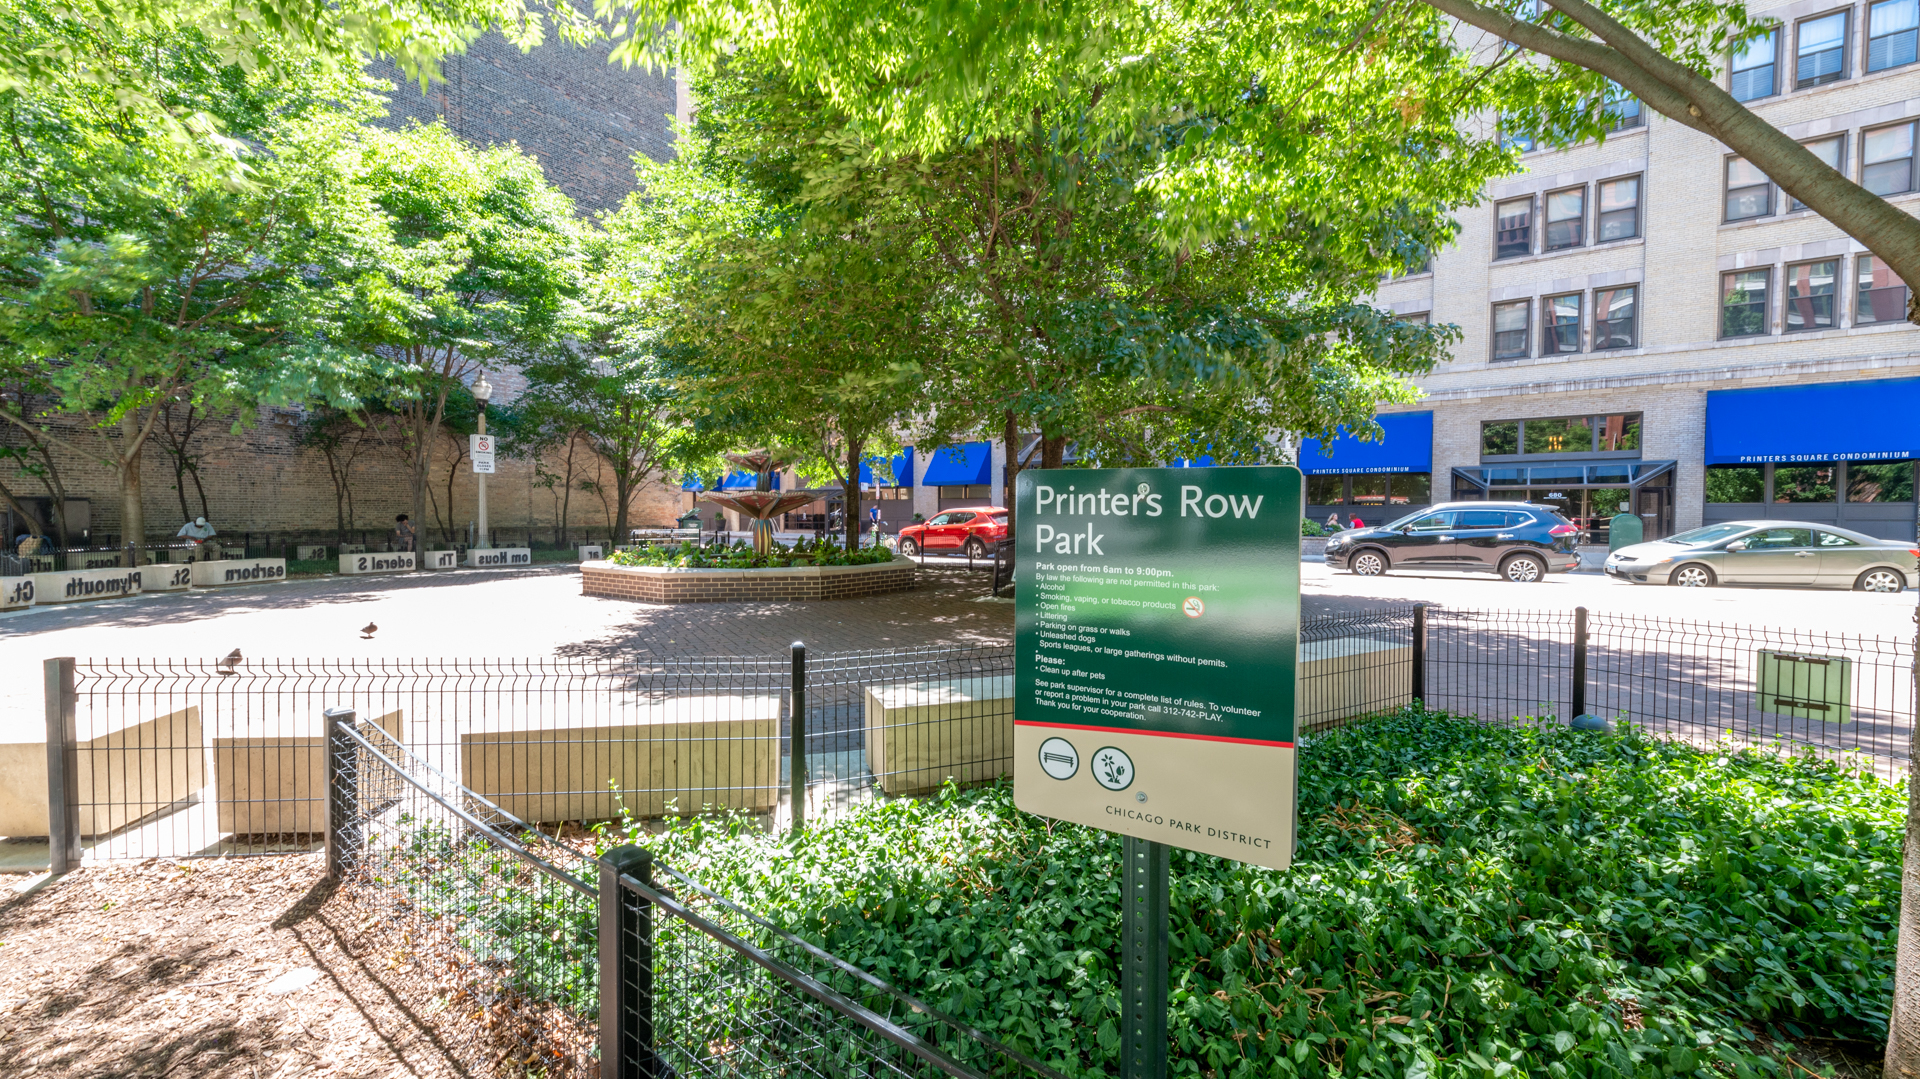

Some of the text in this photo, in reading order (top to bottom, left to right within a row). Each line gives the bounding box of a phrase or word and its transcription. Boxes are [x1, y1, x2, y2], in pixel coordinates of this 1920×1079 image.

[1833, 451, 1910, 460] CONDOMINIUM
[1180, 486, 1264, 519] Row
[1036, 523, 1104, 555] Park
[1036, 562, 1054, 570] Park
[1057, 564, 1078, 573] open
[1080, 564, 1100, 572] from
[1103, 565, 1122, 574] 6am
[1136, 567, 1174, 578] 9:00pm.
[1036, 573, 1045, 581] By
[1072, 575, 1104, 585] following
[1134, 580, 1170, 588] permitted
[1173, 581, 1180, 589] in
[1182, 582, 1196, 590] this
[1199, 584, 1220, 592] park:
[1040, 583, 1065, 591] Alcohol
[1040, 592, 1072, 602] Smoking,
[1074, 596, 1100, 604] vaping,
[1111, 598, 1140, 606] tobacco
[1142, 600, 1176, 610] products
[1040, 602, 1059, 610] Open
[1040, 612, 1068, 621] Littering
[1040, 621, 1066, 630] Parking
[1078, 626, 1098, 634] grass
[1109, 628, 1131, 636] walks
[1040, 631, 1096, 644] Unleashed dogs
[1035, 654, 1066, 665] Please:
[1039, 640, 1061, 648] Sports
[1063, 642, 1092, 653] leagues,
[1104, 647, 1122, 656] large
[1124, 650, 1165, 661] gatherings
[1167, 654, 1196, 664] without
[1040, 665, 1060, 674] Clean
[1090, 672, 1105, 680] pets
[1035, 678, 1048, 687] See
[1067, 684, 1104, 694] supervisor
[1105, 688, 1116, 696] for
[1124, 692, 1158, 702] complete
[1160, 696, 1172, 704] list
[1174, 698, 1182, 706] of
[1184, 700, 1206, 709] rules.
[1208, 702, 1219, 711] To
[1221, 706, 1261, 717] volunteer
[1044, 690, 1064, 698] report
[1072, 694, 1100, 704] problem
[1110, 700, 1127, 708] your
[1129, 702, 1146, 710] park
[1148, 705, 1161, 713] call
[1163, 706, 1224, 722] 312-742-PLAY.
[1035, 697, 1056, 707] Thank
[1101, 708, 1146, 720] cooperation.
[1106, 806, 1271, 849] CHICAGO PARK DISTRICT
